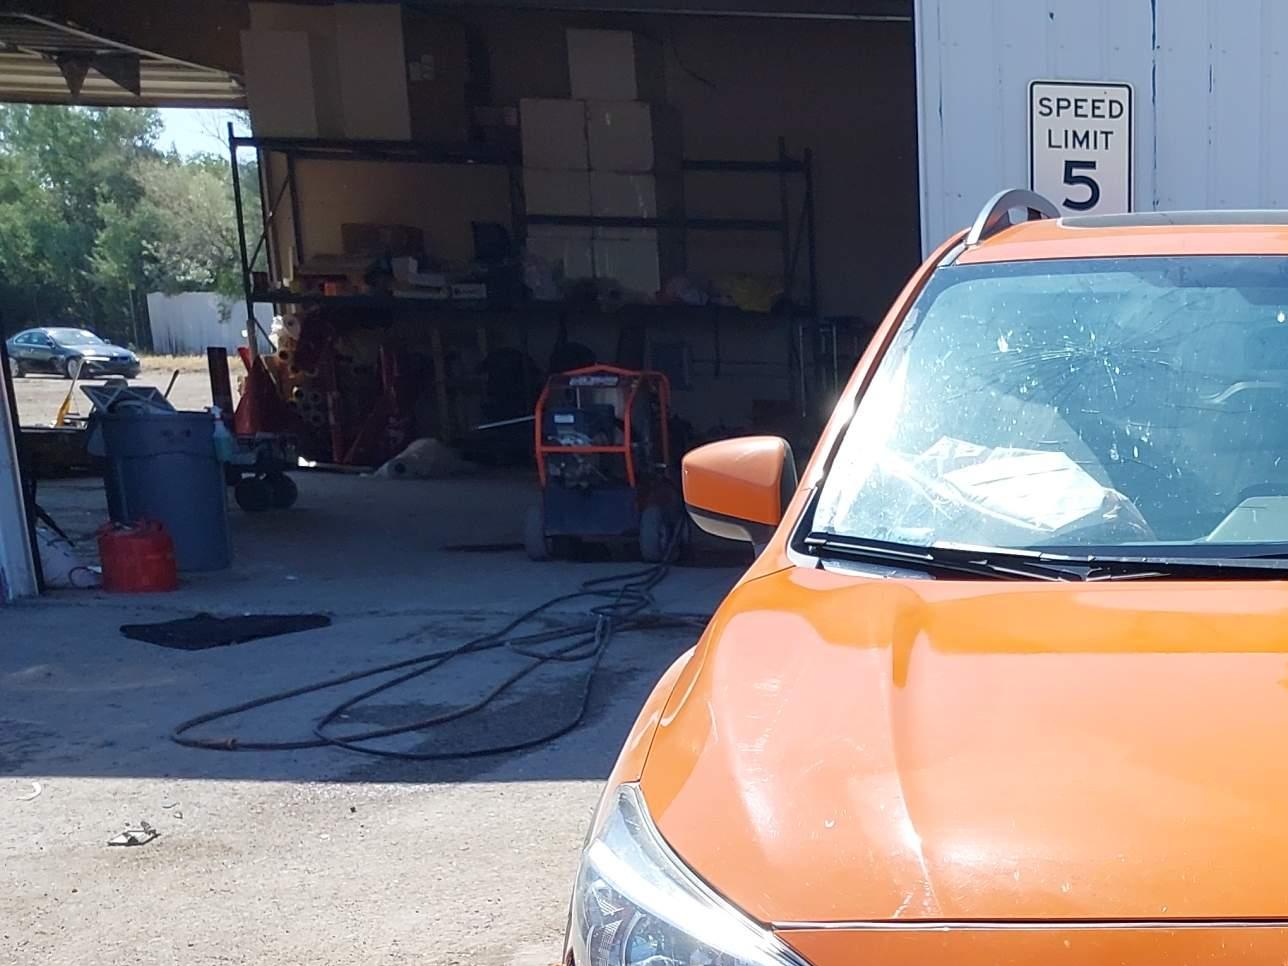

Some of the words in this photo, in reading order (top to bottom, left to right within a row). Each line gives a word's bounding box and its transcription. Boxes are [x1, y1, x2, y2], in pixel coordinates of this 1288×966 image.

[1038, 97, 1124, 119] SPEED
[1048, 129, 1114, 150] LIMIT
[1062, 160, 1100, 211] 5
